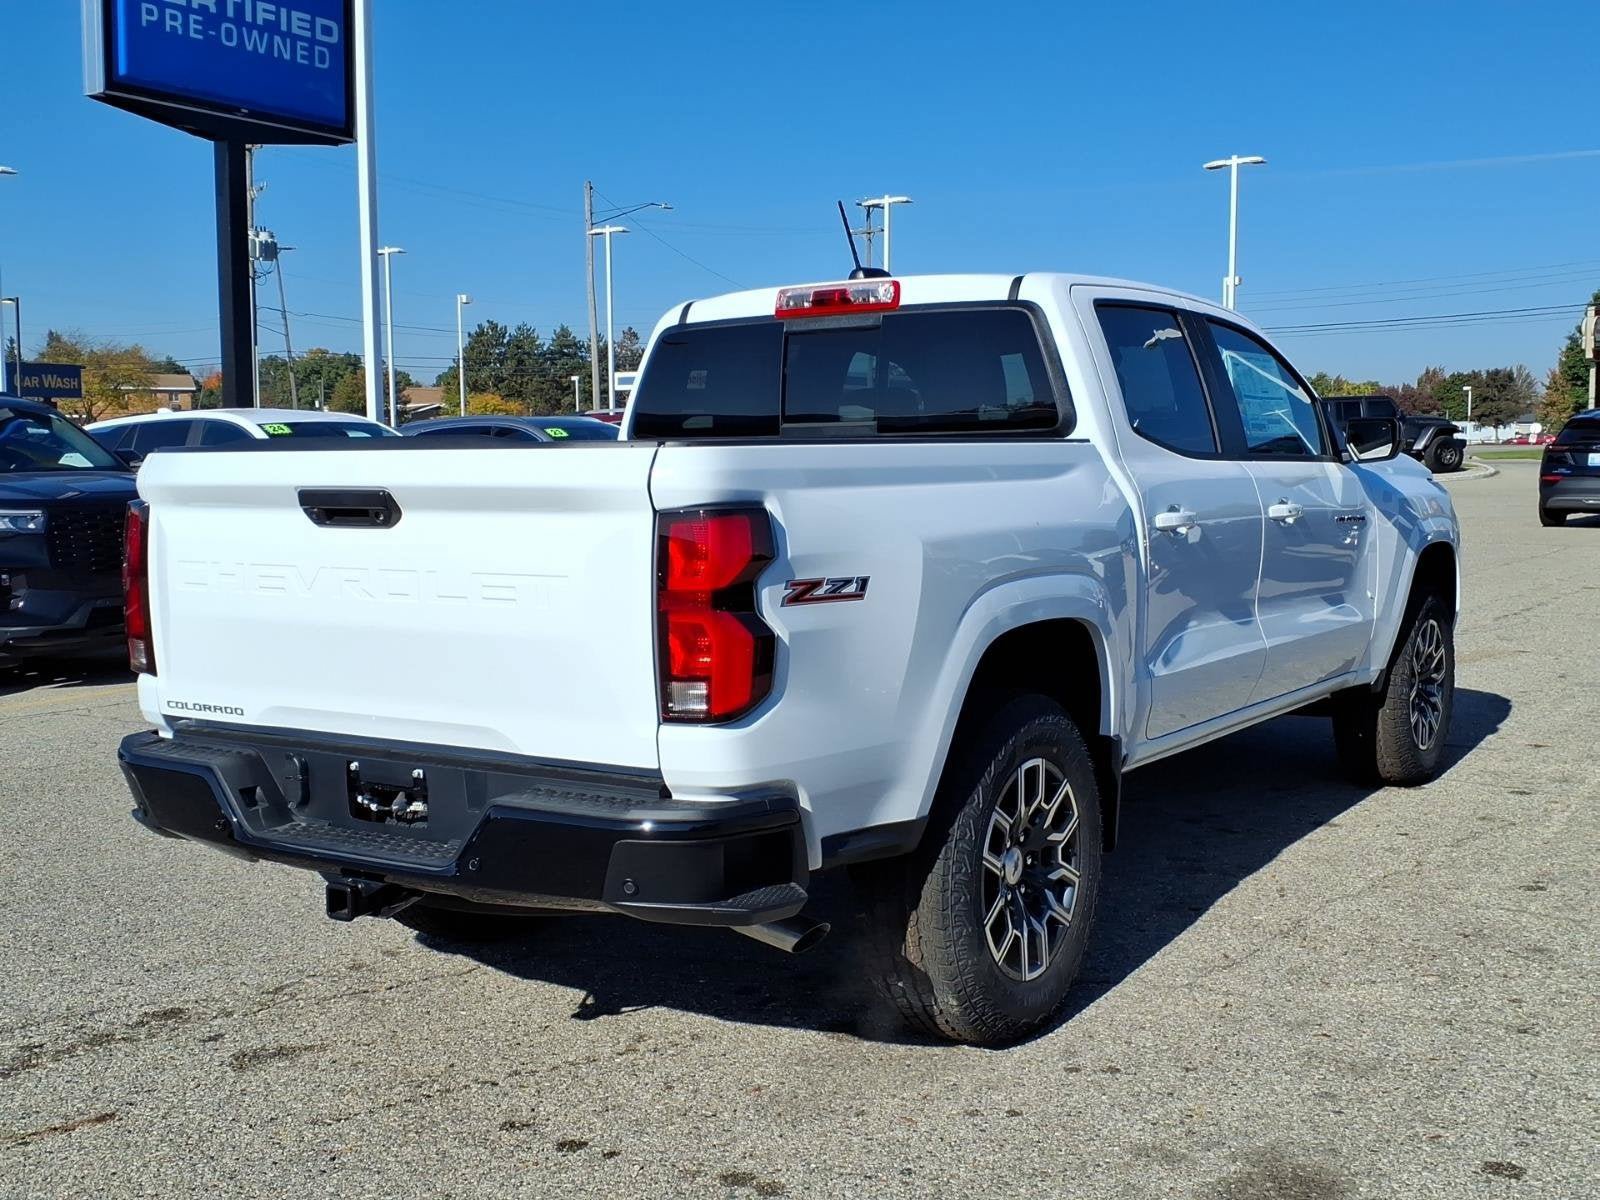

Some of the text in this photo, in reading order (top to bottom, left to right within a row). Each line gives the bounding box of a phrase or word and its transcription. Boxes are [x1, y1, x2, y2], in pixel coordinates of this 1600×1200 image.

[141, 2, 330, 69] PRE-OWNED
[164, 0, 339, 44] RTIFIED
[41, 374, 79, 389] WASH
[177, 560, 569, 609] CHEVROLET
[780, 576, 871, 607] Z71
[166, 700, 245, 716] COLORADO
